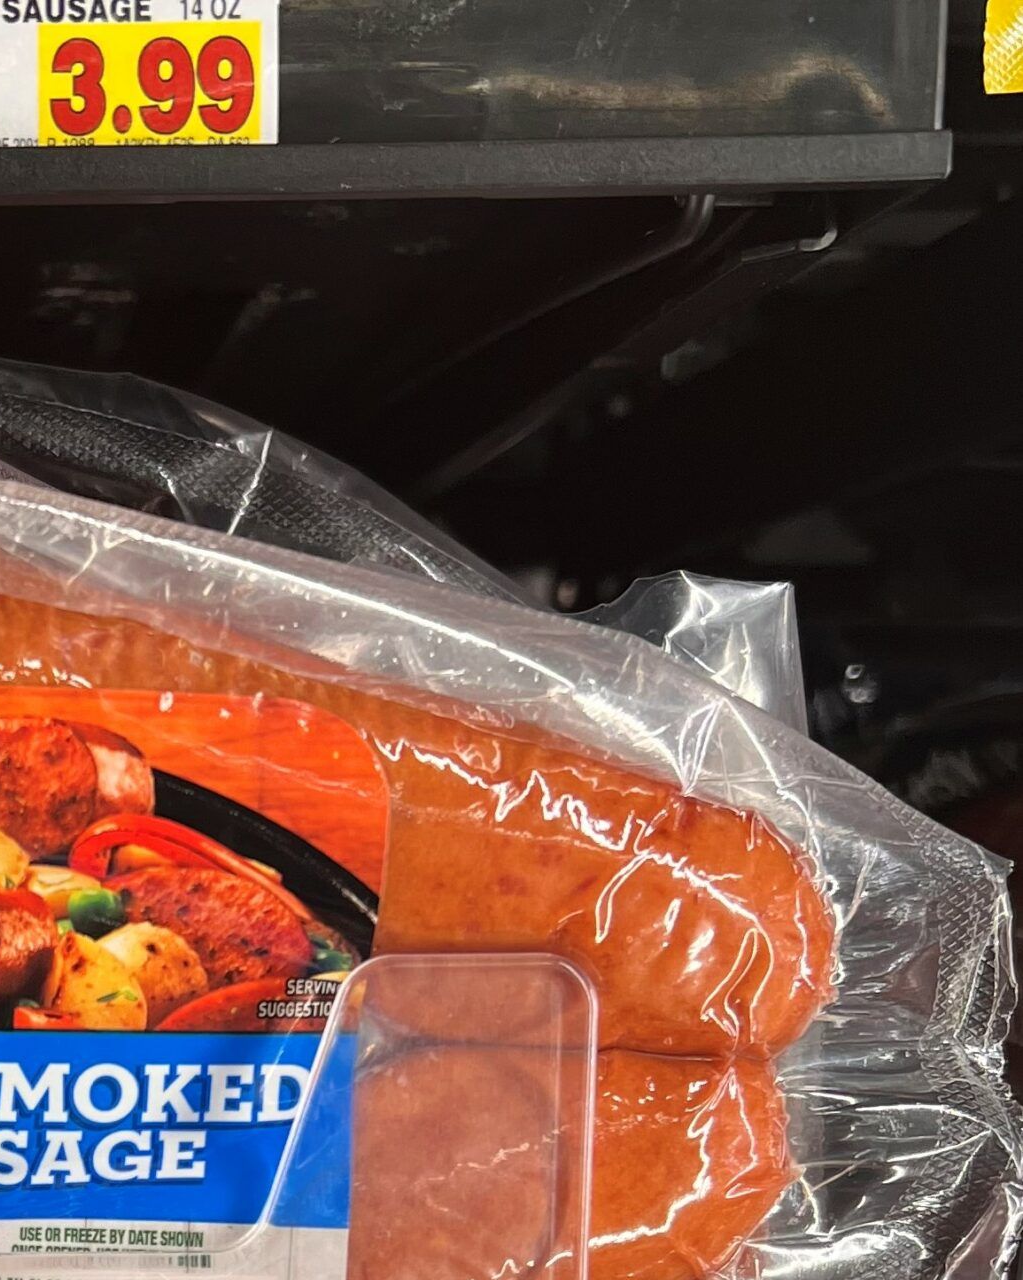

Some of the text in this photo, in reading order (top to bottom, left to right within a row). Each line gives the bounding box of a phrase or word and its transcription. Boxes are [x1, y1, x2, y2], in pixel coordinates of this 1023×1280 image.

[2, 0, 152, 24] SAUSAGE
[182, 0, 202, 20] 14
[211, 0, 241, 19] OZ
[49, 35, 254, 136] 3.99
[287, 979, 341, 995] SERVIN
[258, 1001, 333, 1018] SUGGESTIO
[19, 1227, 204, 1248] USE OR FREEZE BY DATE SHOWN
